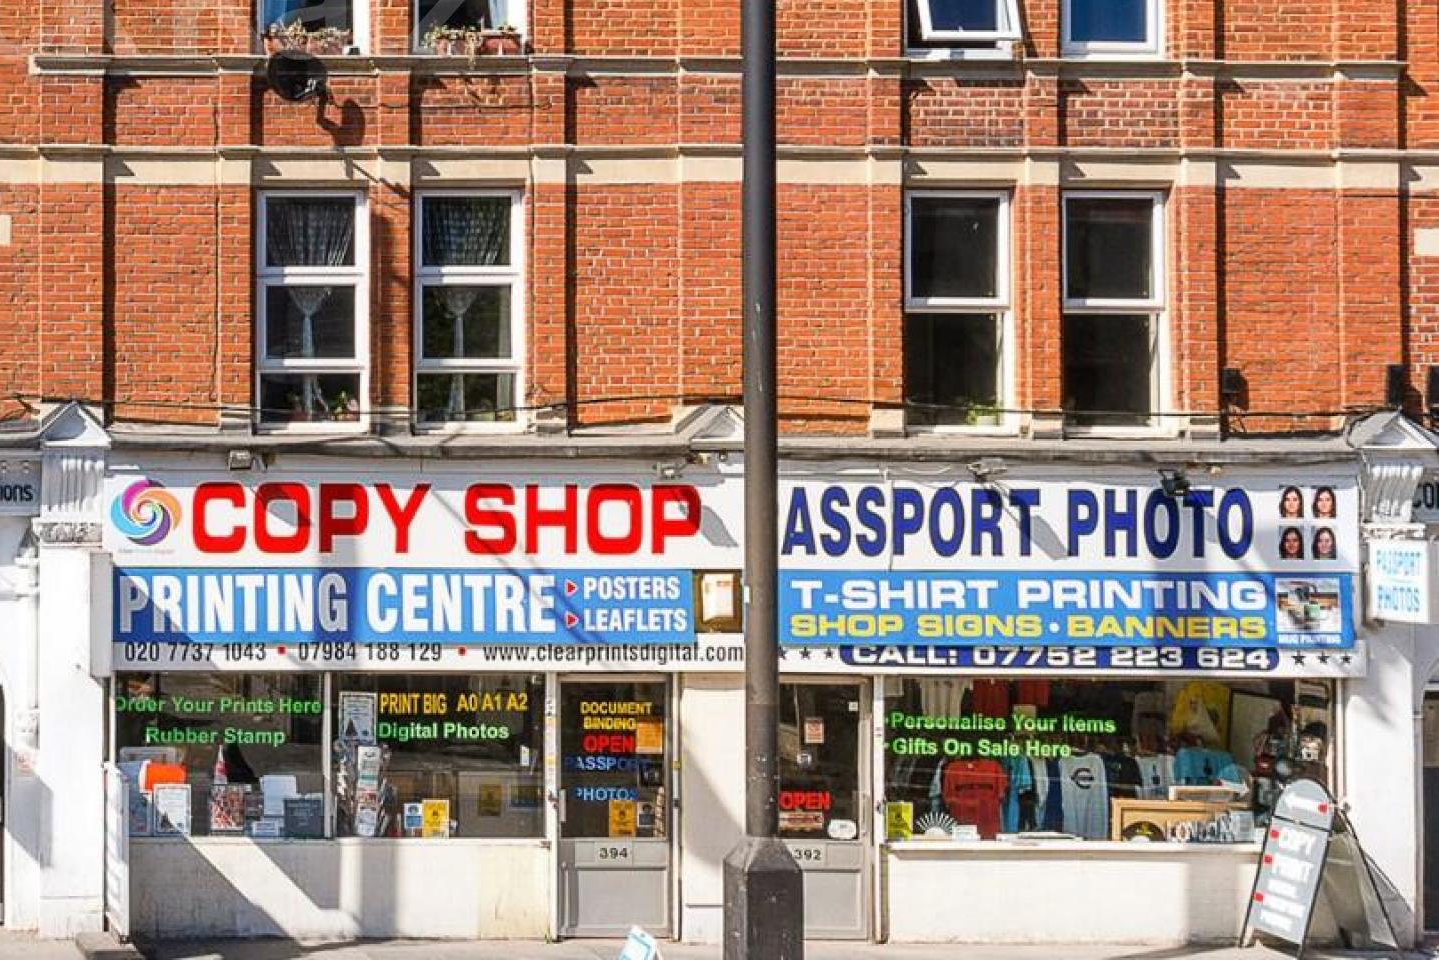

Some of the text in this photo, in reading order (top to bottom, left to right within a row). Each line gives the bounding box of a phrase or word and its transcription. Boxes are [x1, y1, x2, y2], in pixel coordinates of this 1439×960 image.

[193, 482, 703, 556] COPY SHOP
[781, 486, 1254, 560] ASSPORT PHOTO
[583, 575, 680, 600] POSTERS
[790, 579, 1267, 611] T-SHIRT PRINTING
[119, 572, 556, 635] PRINTING CENTRE
[583, 607, 688, 632] LEAFLETS
[790, 614, 1267, 639] SHOP SIGNS BANNERS
[124, 642, 442, 662] 020 7737 1043 07984 188 129
[483, 643, 744, 666] www.clearprintsdigital.com
[852, 645, 1271, 669] CALL: 07752 223 624
[116, 695, 322, 714] Order Your Prints Here
[380, 692, 421, 715] PRINT
[423, 693, 447, 715] BIG
[481, 693, 503, 712] A1
[507, 692, 529, 712] A2
[580, 701, 653, 714] DOCUMENT
[379, 723, 510, 742] Digital Photos
[891, 712, 1117, 733] Personalise Your Items
[146, 726, 286, 747] Rubber Stamp
[582, 734, 635, 753] OPEN
[893, 738, 1072, 758] Gifts On Sale Here
[779, 790, 831, 810] OPEN
[599, 847, 628, 860] 394
[793, 848, 821, 861] 392
